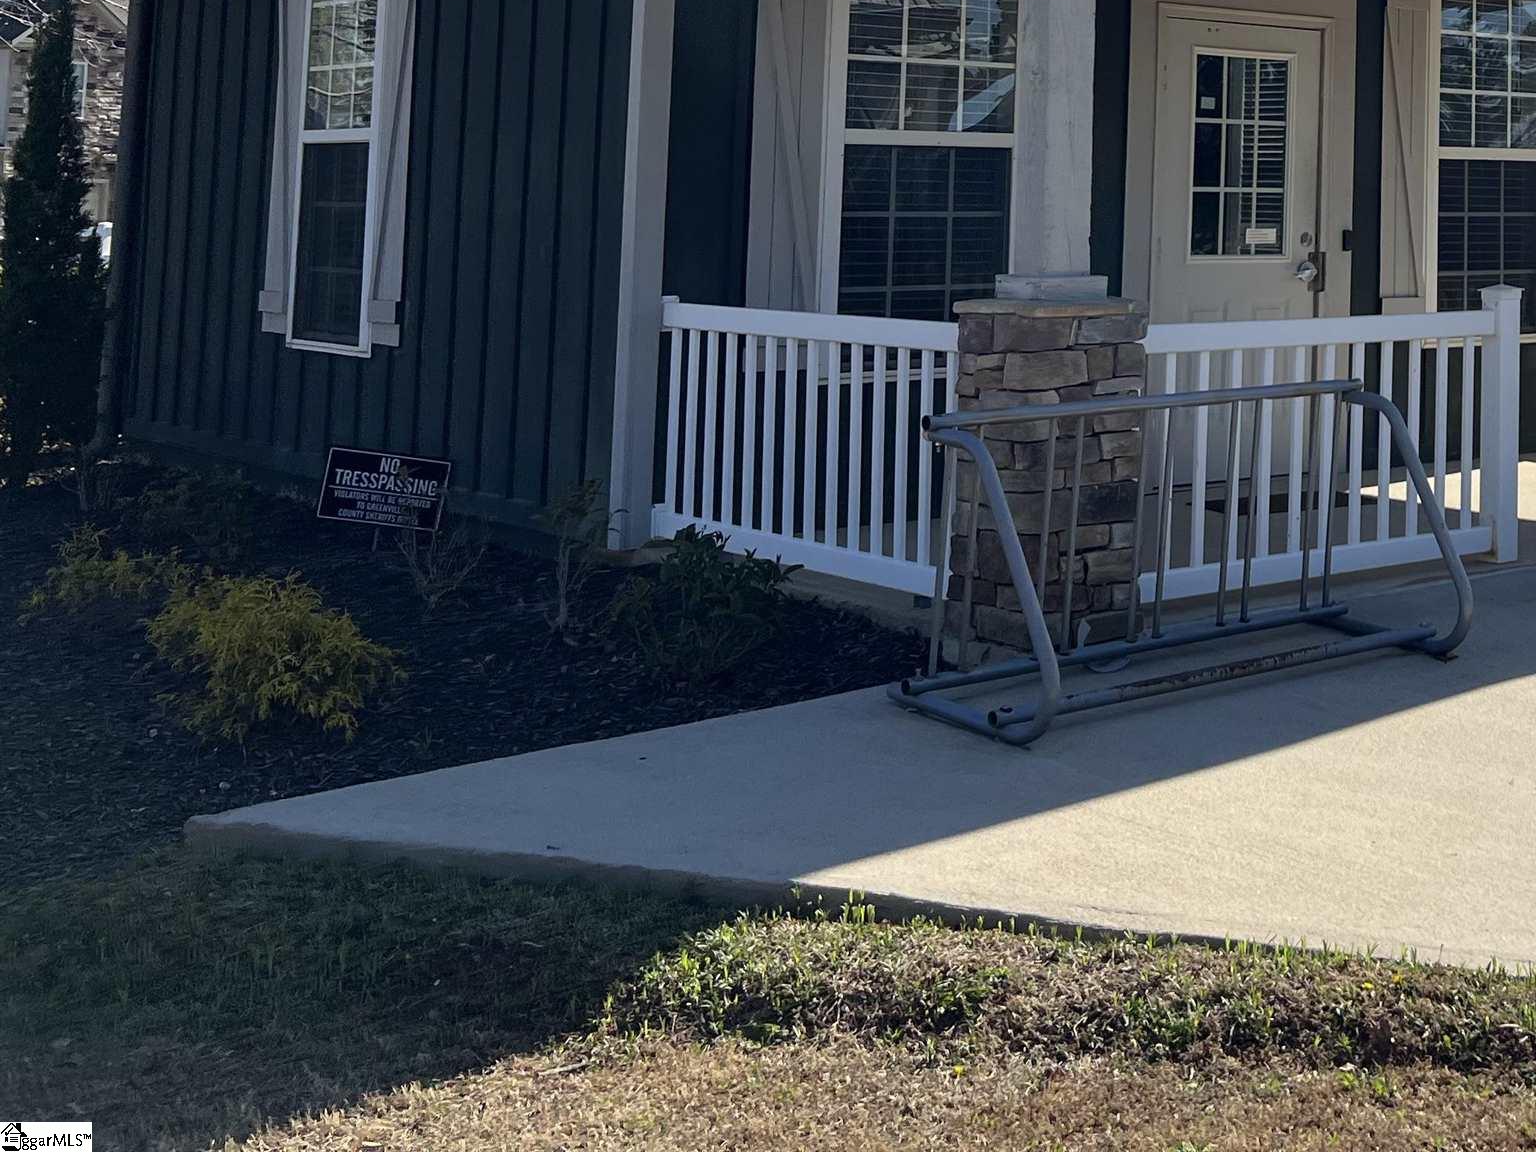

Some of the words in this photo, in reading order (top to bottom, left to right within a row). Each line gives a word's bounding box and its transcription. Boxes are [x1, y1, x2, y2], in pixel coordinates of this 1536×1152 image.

[380, 457, 401, 474] NO
[334, 489, 369, 501] VIOLATORS
[370, 494, 386, 503] WILL
[388, 496, 398, 505] BE
[356, 500, 365, 509] TO
[338, 508, 364, 519] COUNTY
